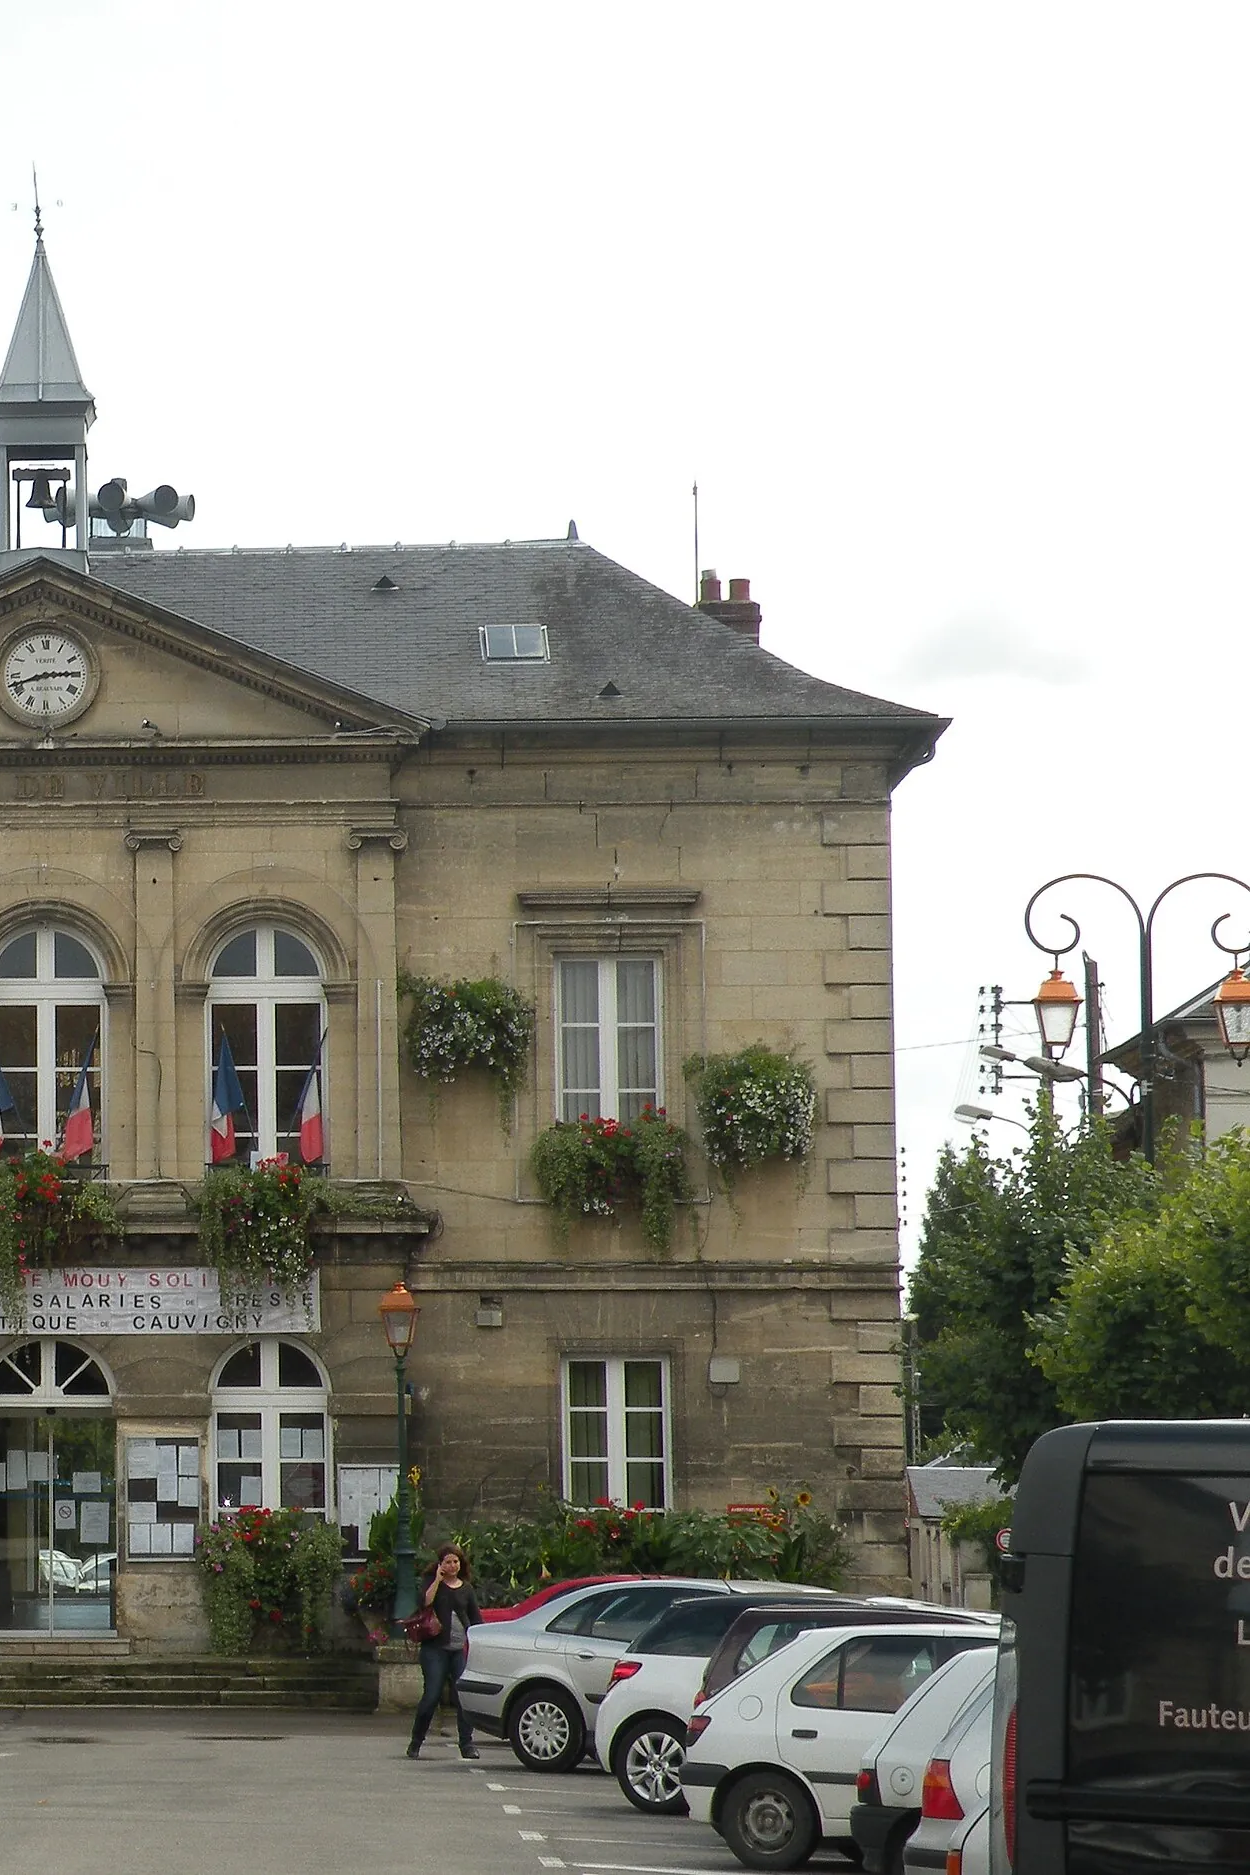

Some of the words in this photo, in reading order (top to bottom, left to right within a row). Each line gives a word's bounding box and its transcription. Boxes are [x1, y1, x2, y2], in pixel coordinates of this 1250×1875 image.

[14, 774, 65, 799] DE
[86, 772, 206, 798] VILLE
[63, 1273, 127, 1288] MOUY
[32, 1294, 162, 1310] SALARIES
[132, 1314, 263, 1330] CAUVIGNY
[1158, 1700, 1250, 1731] Fauteu
